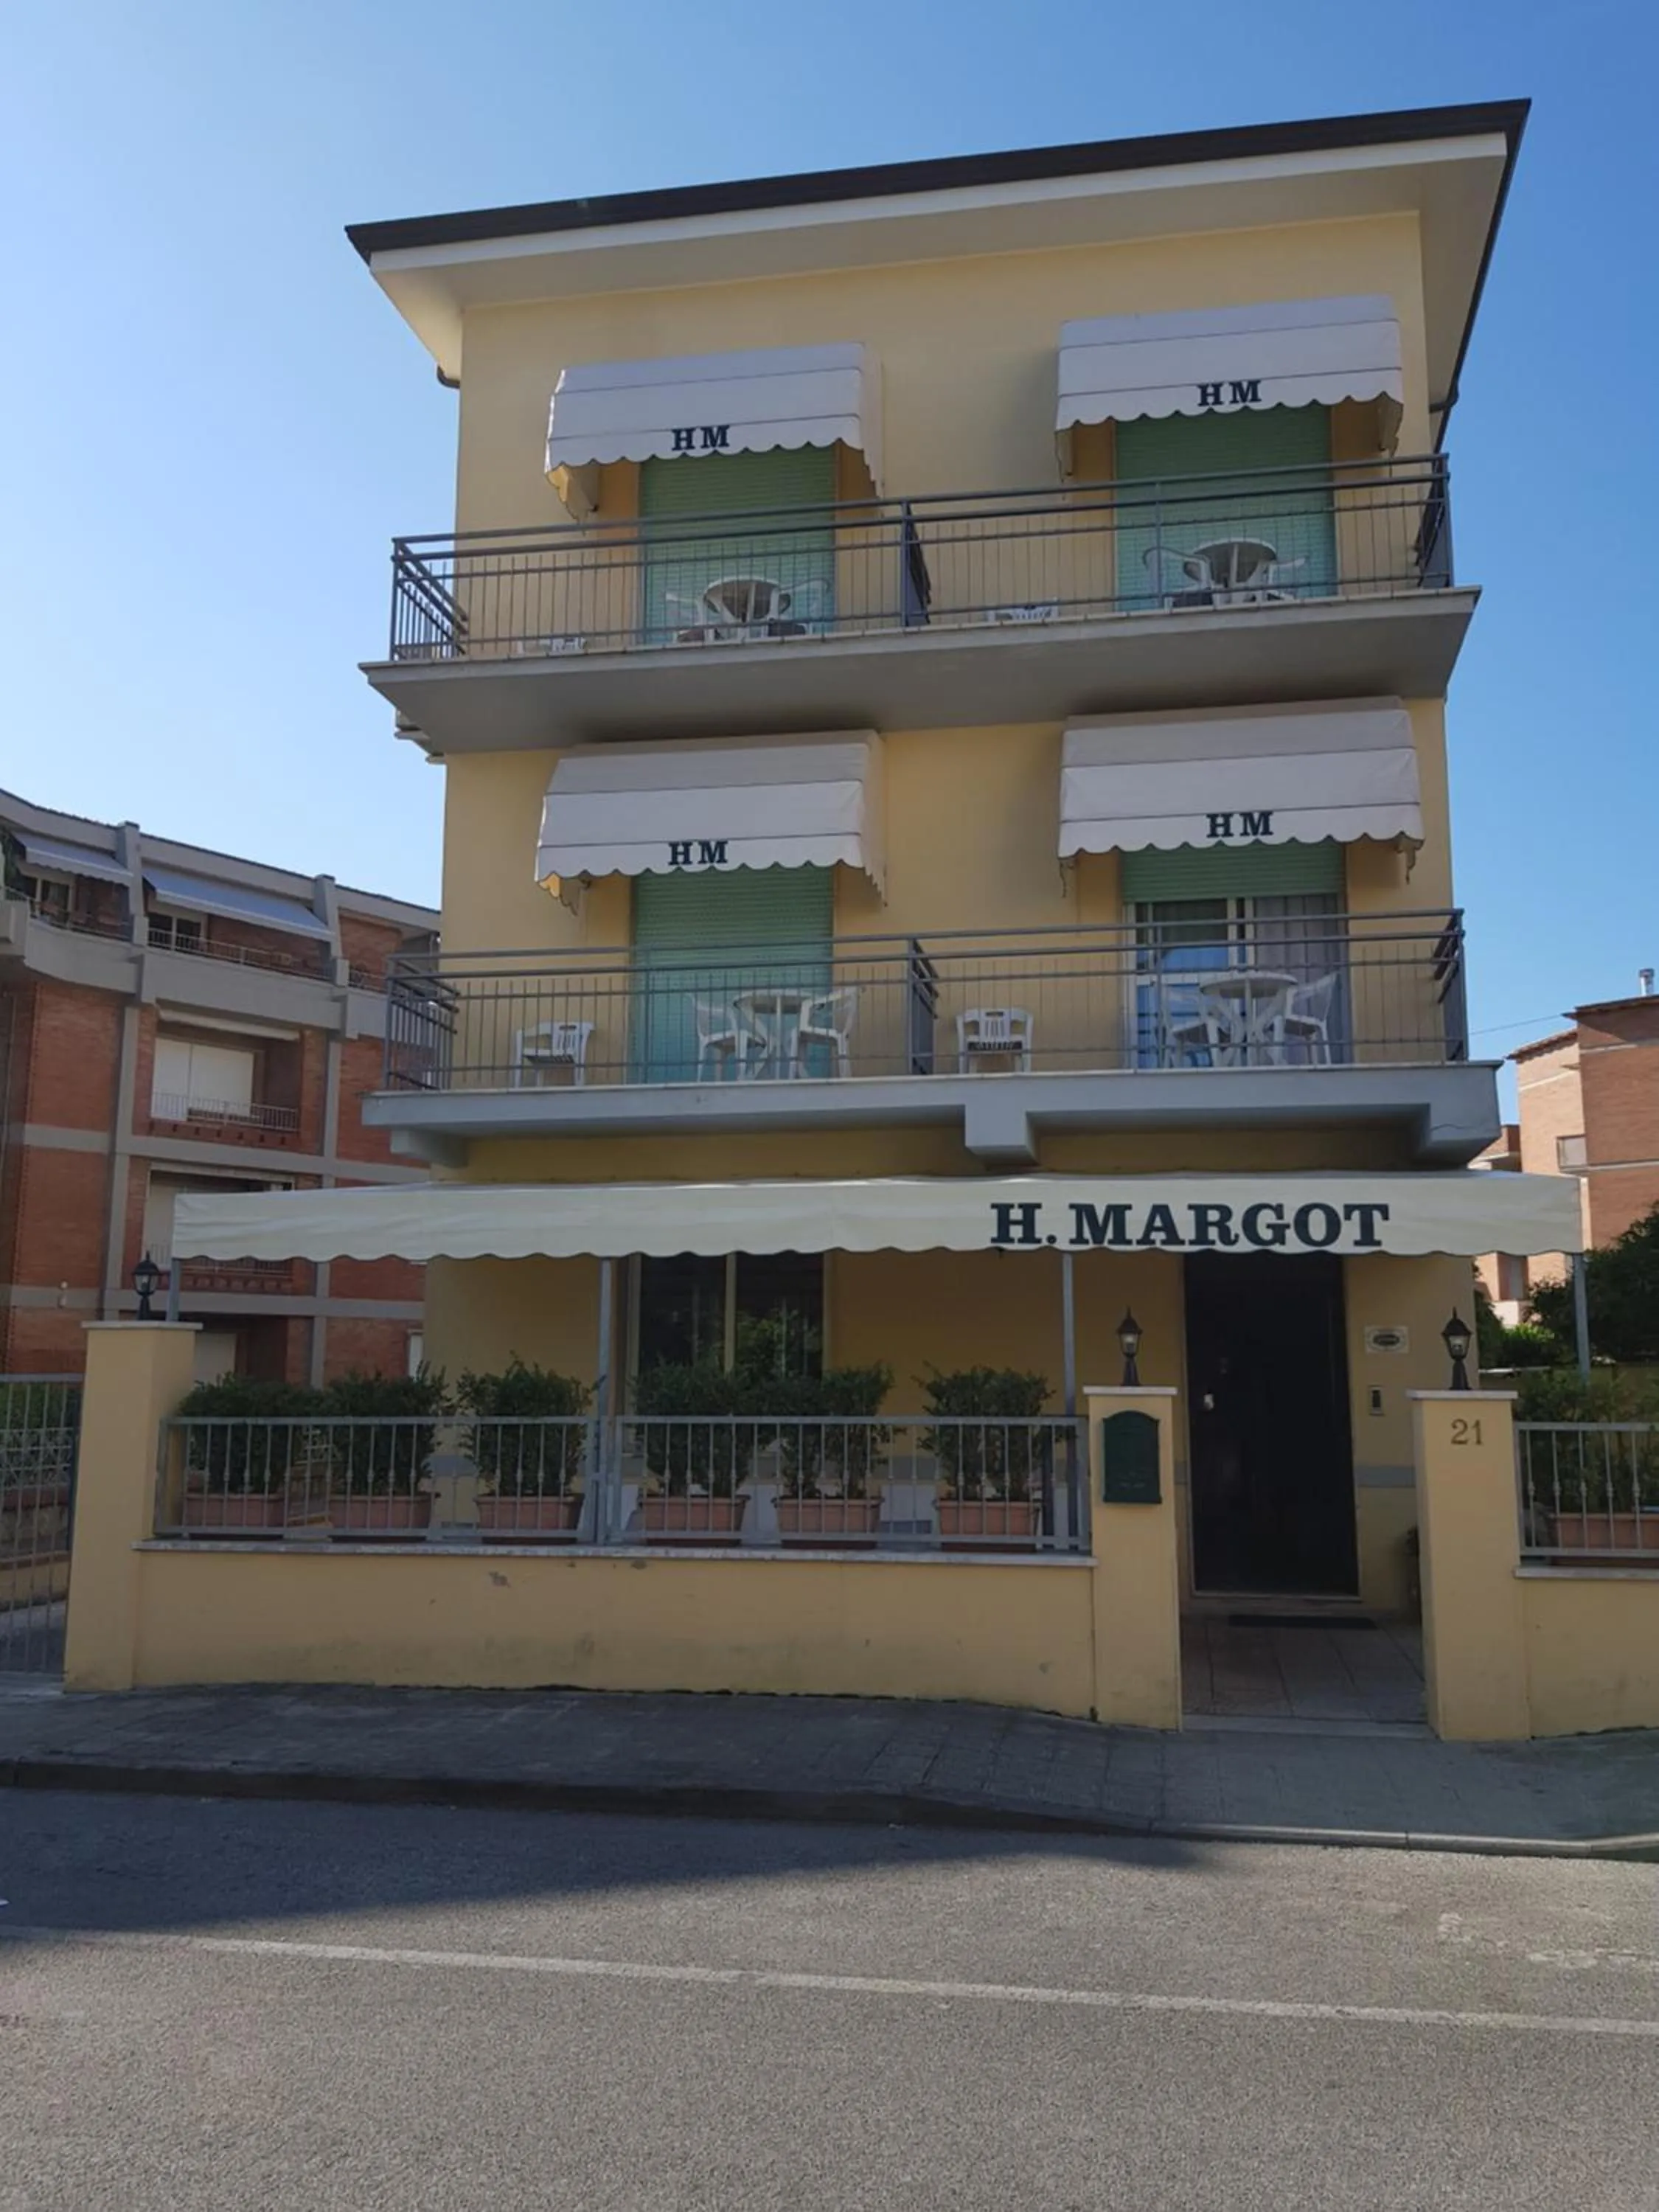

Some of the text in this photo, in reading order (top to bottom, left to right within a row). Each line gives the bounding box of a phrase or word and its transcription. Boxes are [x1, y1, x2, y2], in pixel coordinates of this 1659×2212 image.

[1197, 379, 1262, 406] HM
[672, 425, 730, 451] HM
[1206, 810, 1275, 838] HM
[667, 840, 729, 866] HM
[1450, 1419, 1485, 1446] 21
